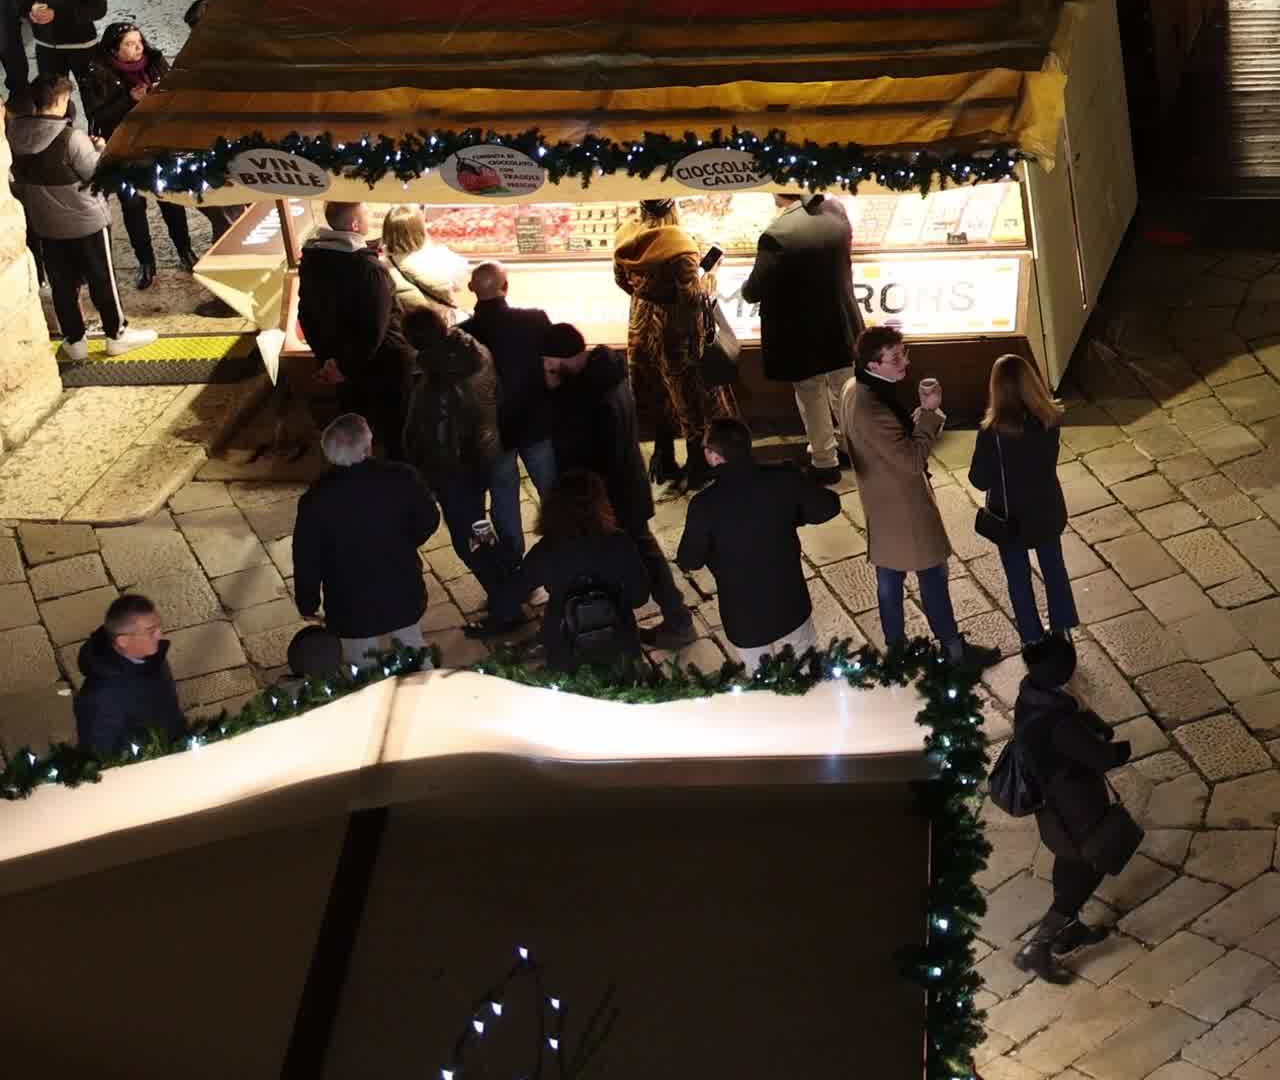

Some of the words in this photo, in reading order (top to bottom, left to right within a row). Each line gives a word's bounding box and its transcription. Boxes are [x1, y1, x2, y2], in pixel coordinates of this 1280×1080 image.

[248, 158, 300, 172] VIN
[676, 161, 760, 180] CIOCCOLA
[702, 174, 759, 186] CALDA
